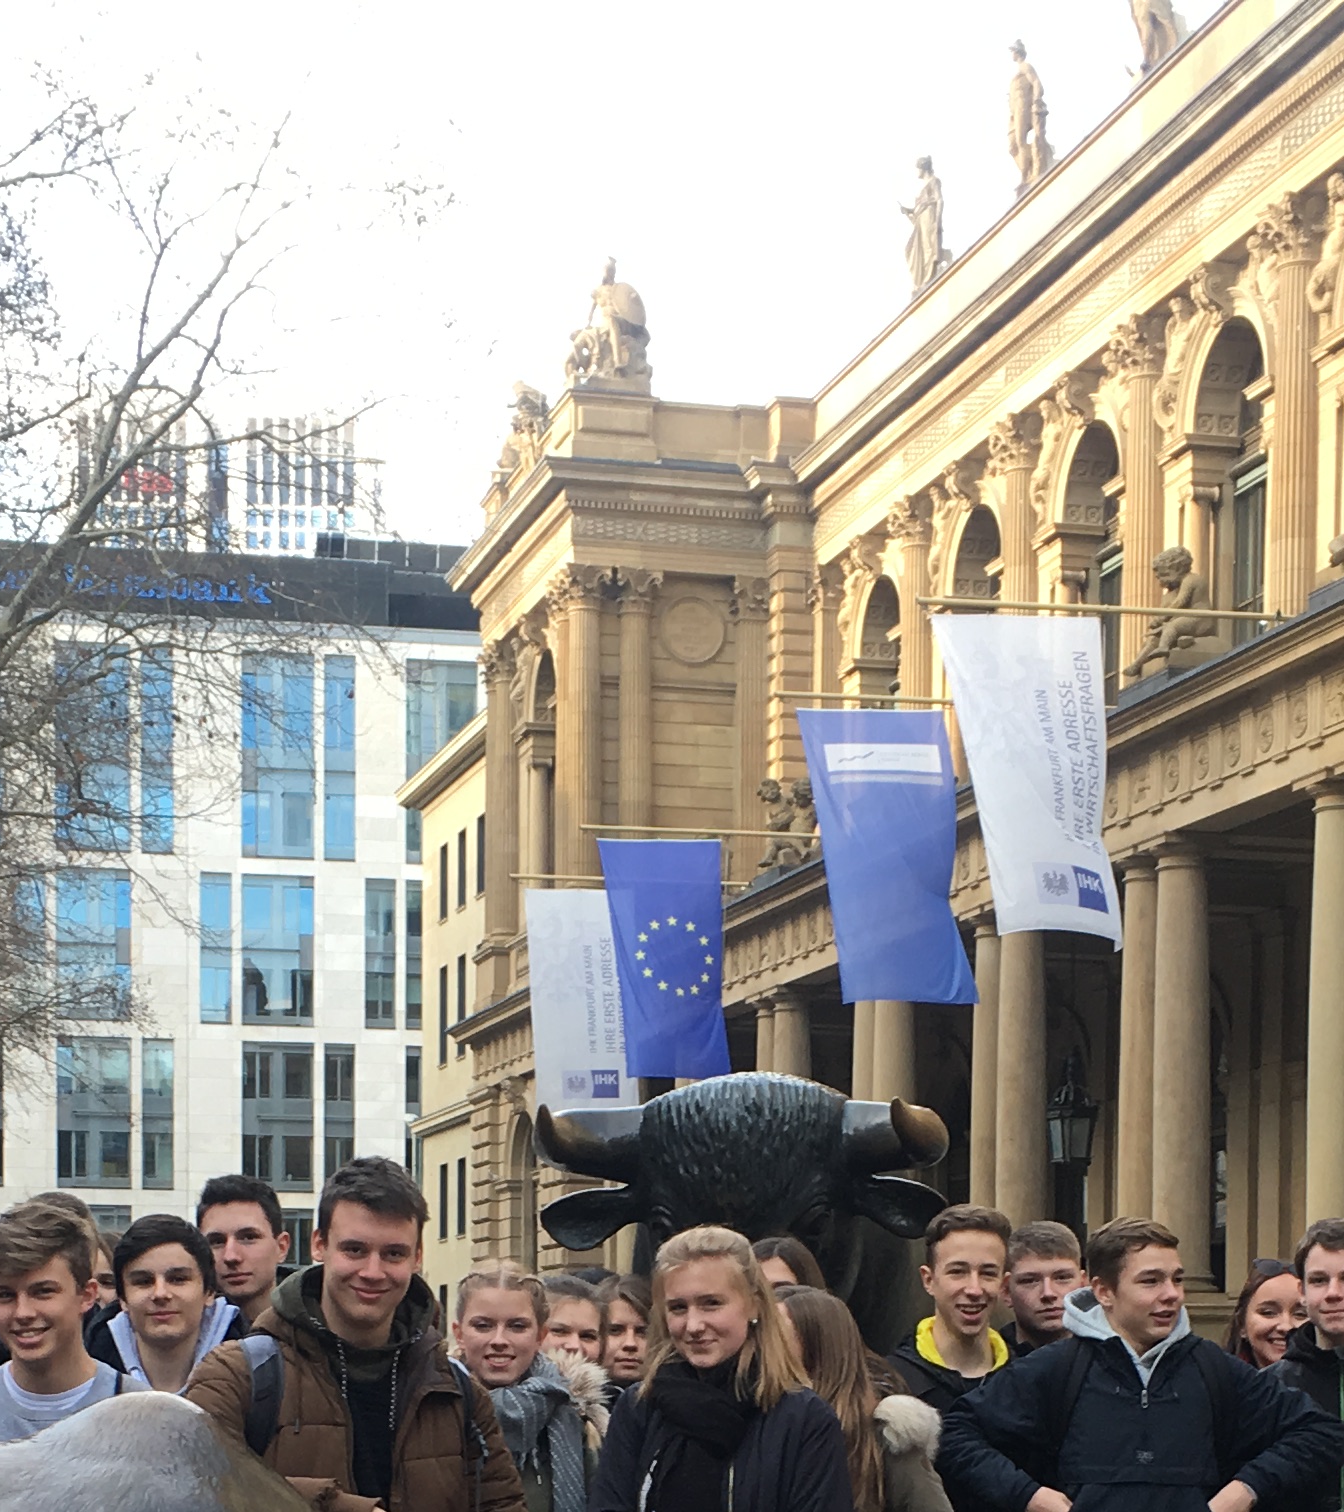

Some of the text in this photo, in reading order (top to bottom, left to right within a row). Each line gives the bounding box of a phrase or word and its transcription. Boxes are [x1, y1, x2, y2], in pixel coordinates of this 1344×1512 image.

[1034, 689, 1065, 821] FRANKFURT AM MAIN
[1057, 680, 1081, 753] ADRESSE
[1072, 651, 1099, 834] WIRTSCHAFTSFRAGEN
[1070, 756, 1085, 809] ERSTE
[1077, 873, 1104, 894] IHK
[583, 944, 597, 1054] IHK FRANKFURT AM MAIN
[599, 937, 616, 1054] IHRE ERSTE ADRESSE
[594, 1073, 618, 1085] IHK
